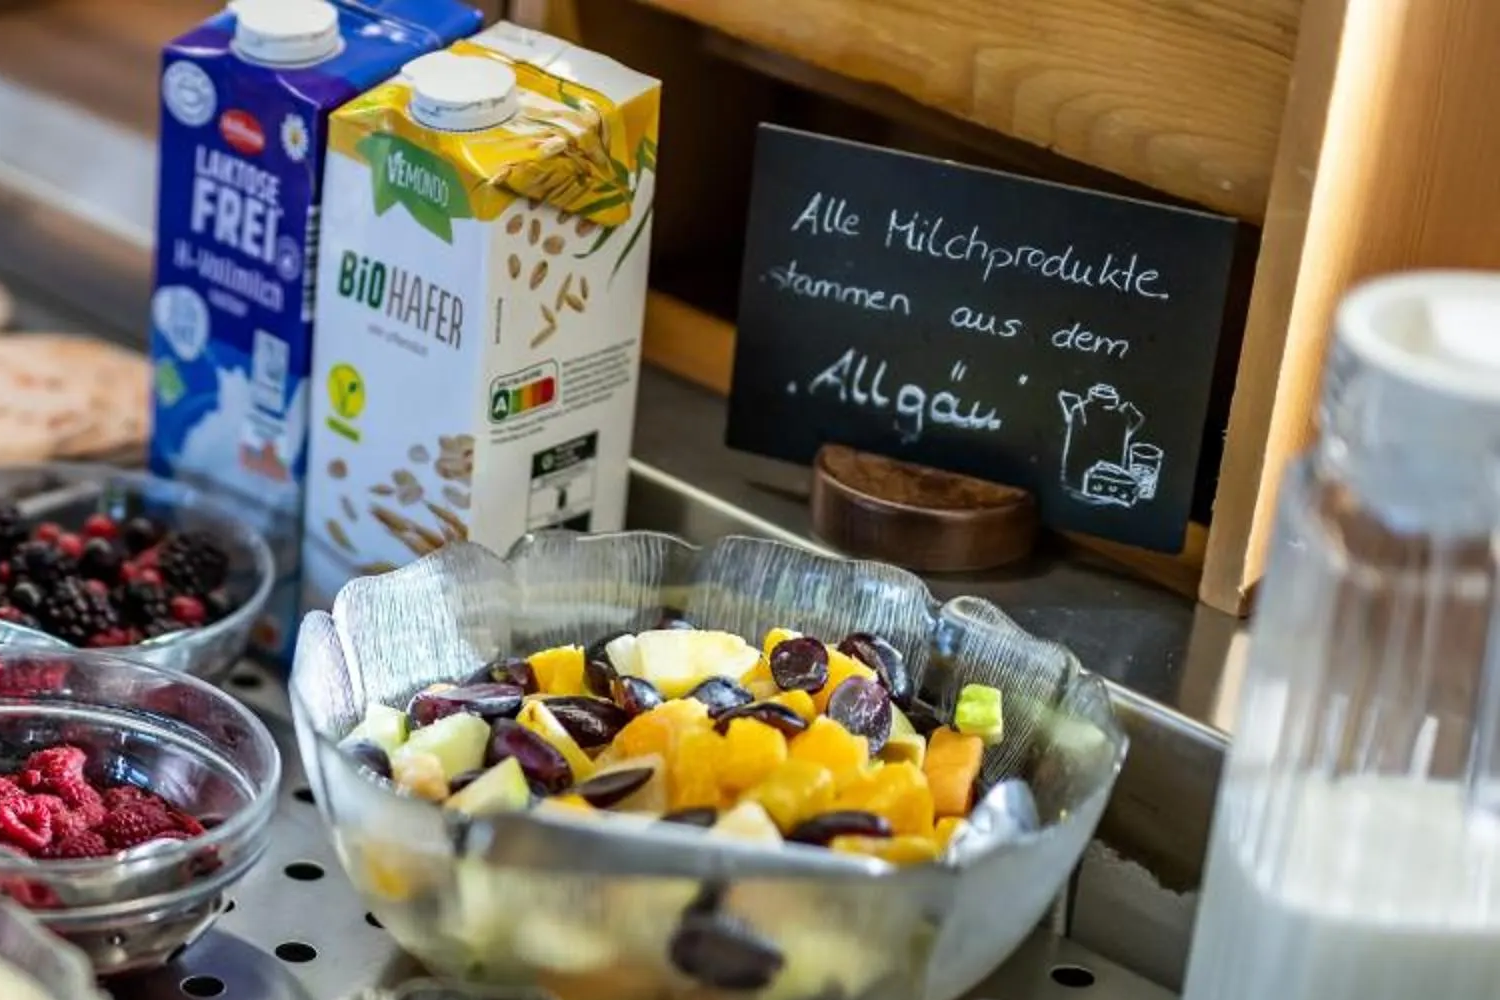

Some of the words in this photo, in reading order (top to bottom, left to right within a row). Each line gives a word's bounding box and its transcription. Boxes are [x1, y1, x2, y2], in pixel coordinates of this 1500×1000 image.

[194, 144, 281, 205] LAKTOSE
[387, 150, 450, 208] VEMONDO
[791, 192, 860, 235] Alle
[386, 266, 464, 350] HAFER
[769, 260, 911, 316] stammen
[950, 307, 1022, 338] aus
[1052, 322, 1130, 359] dem
